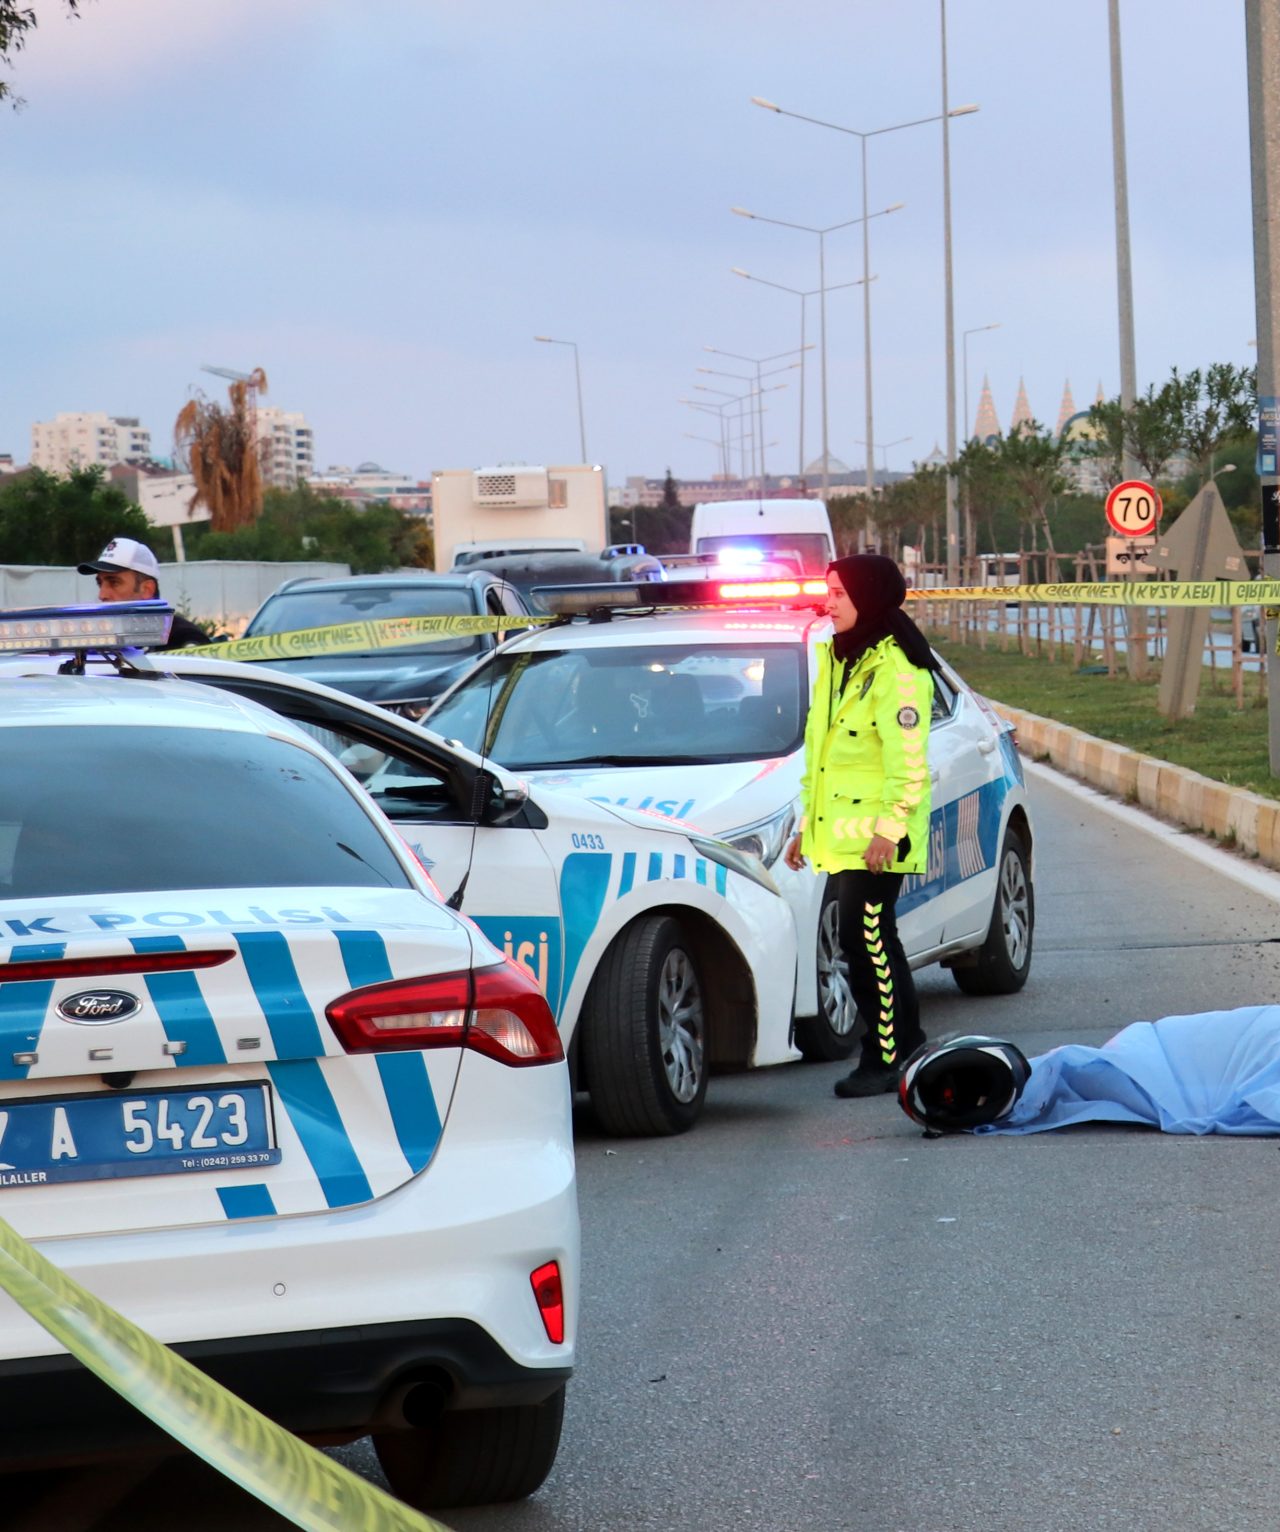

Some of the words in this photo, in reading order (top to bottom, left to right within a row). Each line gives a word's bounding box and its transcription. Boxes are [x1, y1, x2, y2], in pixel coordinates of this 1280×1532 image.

[1118, 496, 1151, 522] 70
[571, 832, 605, 850] 0433
[89, 906, 353, 930] POLİSİ
[74, 995, 123, 1016] Ford
[51, 1107, 78, 1160] A
[122, 1093, 249, 1154] 5423
[182, 1158, 195, 1168] Tel
[201, 1156, 229, 1168] (0242)
[231, 1156, 246, 1164] 259
[248, 1155, 258, 1163] 33
[259, 1153, 269, 1162] 70
